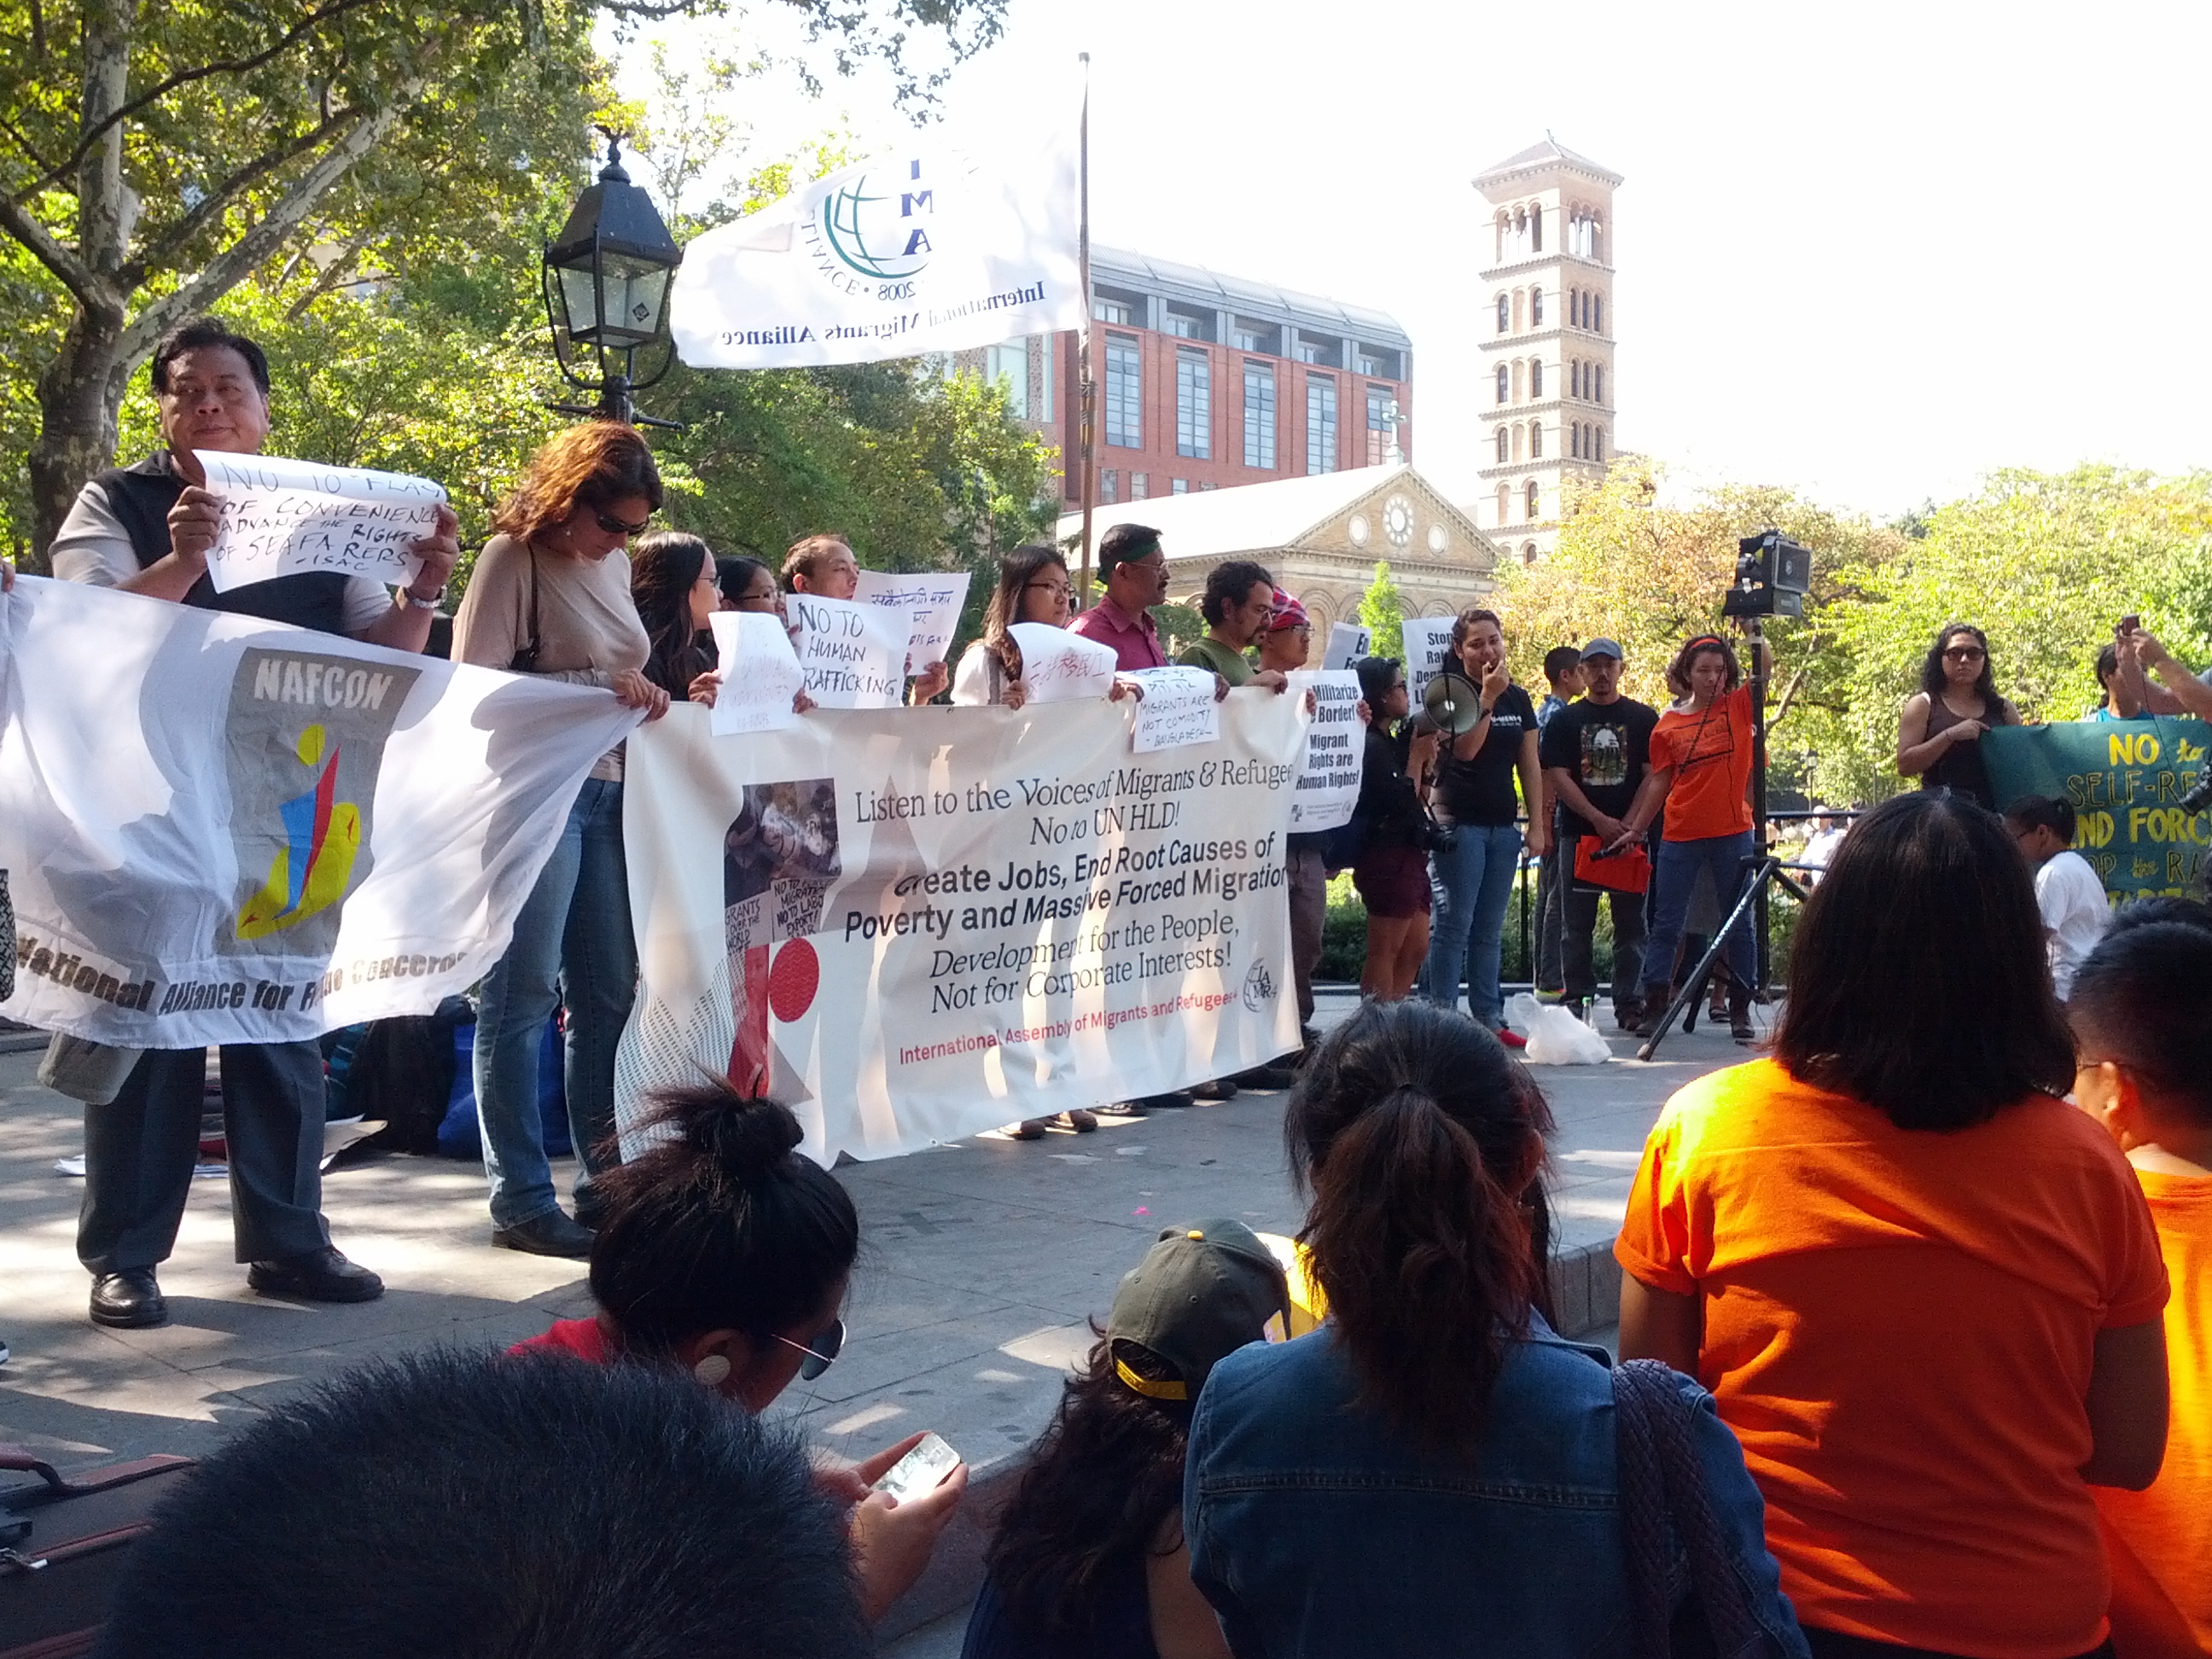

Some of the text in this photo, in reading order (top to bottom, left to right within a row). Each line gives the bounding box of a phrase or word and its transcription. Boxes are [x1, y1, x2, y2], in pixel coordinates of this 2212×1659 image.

[219, 499, 258, 515] OF
[220, 517, 423, 544] ADVANCE THE RIGHTS
[216, 545, 237, 562] OF
[799, 602, 864, 637] NO TO
[807, 636, 866, 661] HUMAN
[253, 658, 393, 711] NAFCON
[1312, 684, 1358, 701] Militarize
[1140, 695, 1210, 716] MIGRANTS ARE
[1318, 704, 1354, 723] Border!
[1142, 718, 1163, 733] NOT
[1309, 733, 1348, 750] Migrant
[2109, 734, 2206, 765] NO to
[1308, 753, 1353, 770] Rights are
[855, 791, 925, 823] Listen
[934, 791, 958, 815] to
[967, 783, 1012, 812] the
[1016, 777, 1095, 806] Voices
[1096, 771, 1114, 800] of
[1115, 768, 1195, 800] Migrants
[1199, 760, 1217, 787] &
[1295, 770, 1359, 790] Human Rights!
[1030, 800, 1180, 845] No to UN HLD!
[2069, 808, 2212, 849] ND FORC
[998, 860, 1067, 891] Jobs,
[1074, 849, 1111, 883] End
[1115, 844, 1166, 874] Root
[1169, 839, 1247, 866] Causes
[1254, 831, 1276, 859] of
[774, 882, 786, 897] NO
[846, 905, 954, 943] Poverty
[961, 898, 1017, 930] and
[1022, 887, 1110, 924] Massive
[1115, 871, 1186, 907] Forced
[929, 909, 1239, 979] Development for the People,
[17, 934, 156, 1012] National
[159, 980, 246, 1016] Alliance
[250, 979, 293, 1012] for
[932, 941, 1231, 1013] Not for Corporate Interests!
[899, 1029, 1003, 1065] International
[1005, 1019, 1072, 1045] Assembly
[1074, 1014, 1087, 1032] of
[1091, 1005, 1148, 1030] Migrants
[1152, 998, 1174, 1016] and
